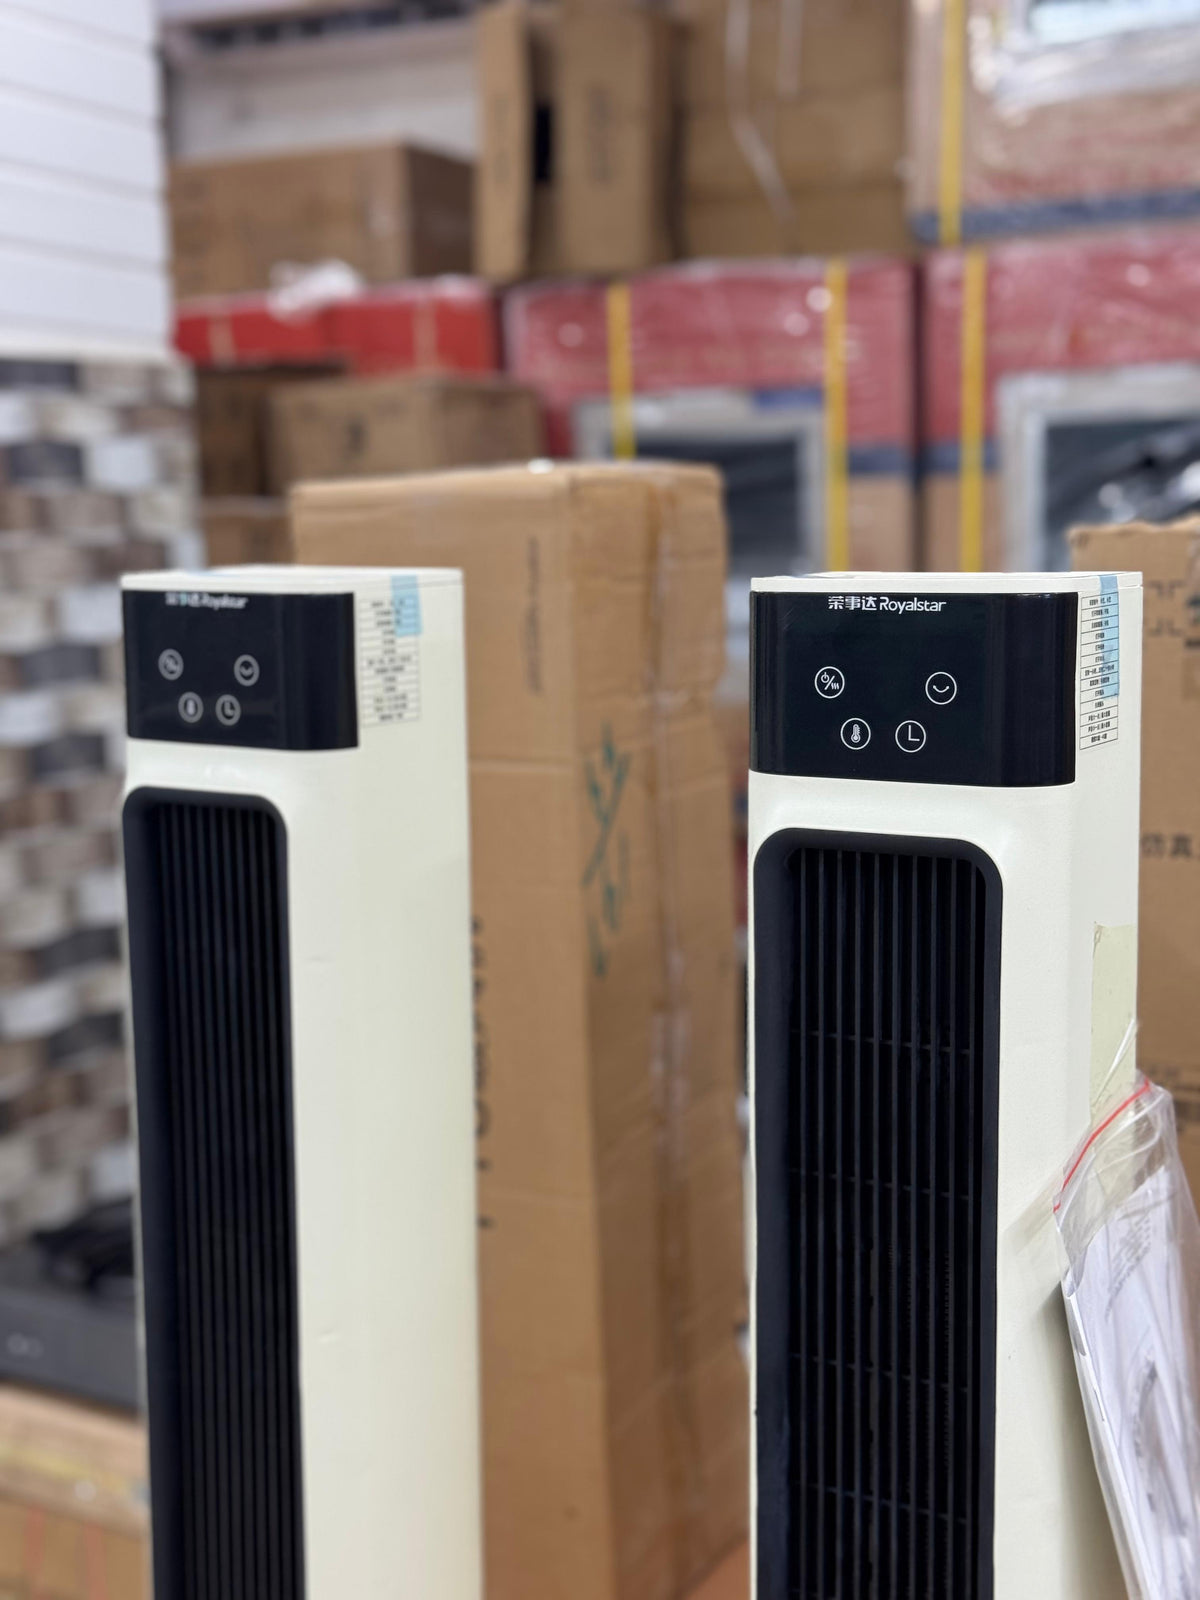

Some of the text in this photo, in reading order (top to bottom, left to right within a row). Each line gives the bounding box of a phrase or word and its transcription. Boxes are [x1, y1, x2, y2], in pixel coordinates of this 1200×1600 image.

[828, 596, 947, 614] 荣事达 Royalstar
[1141, 832, 1200, 859] 仿真
